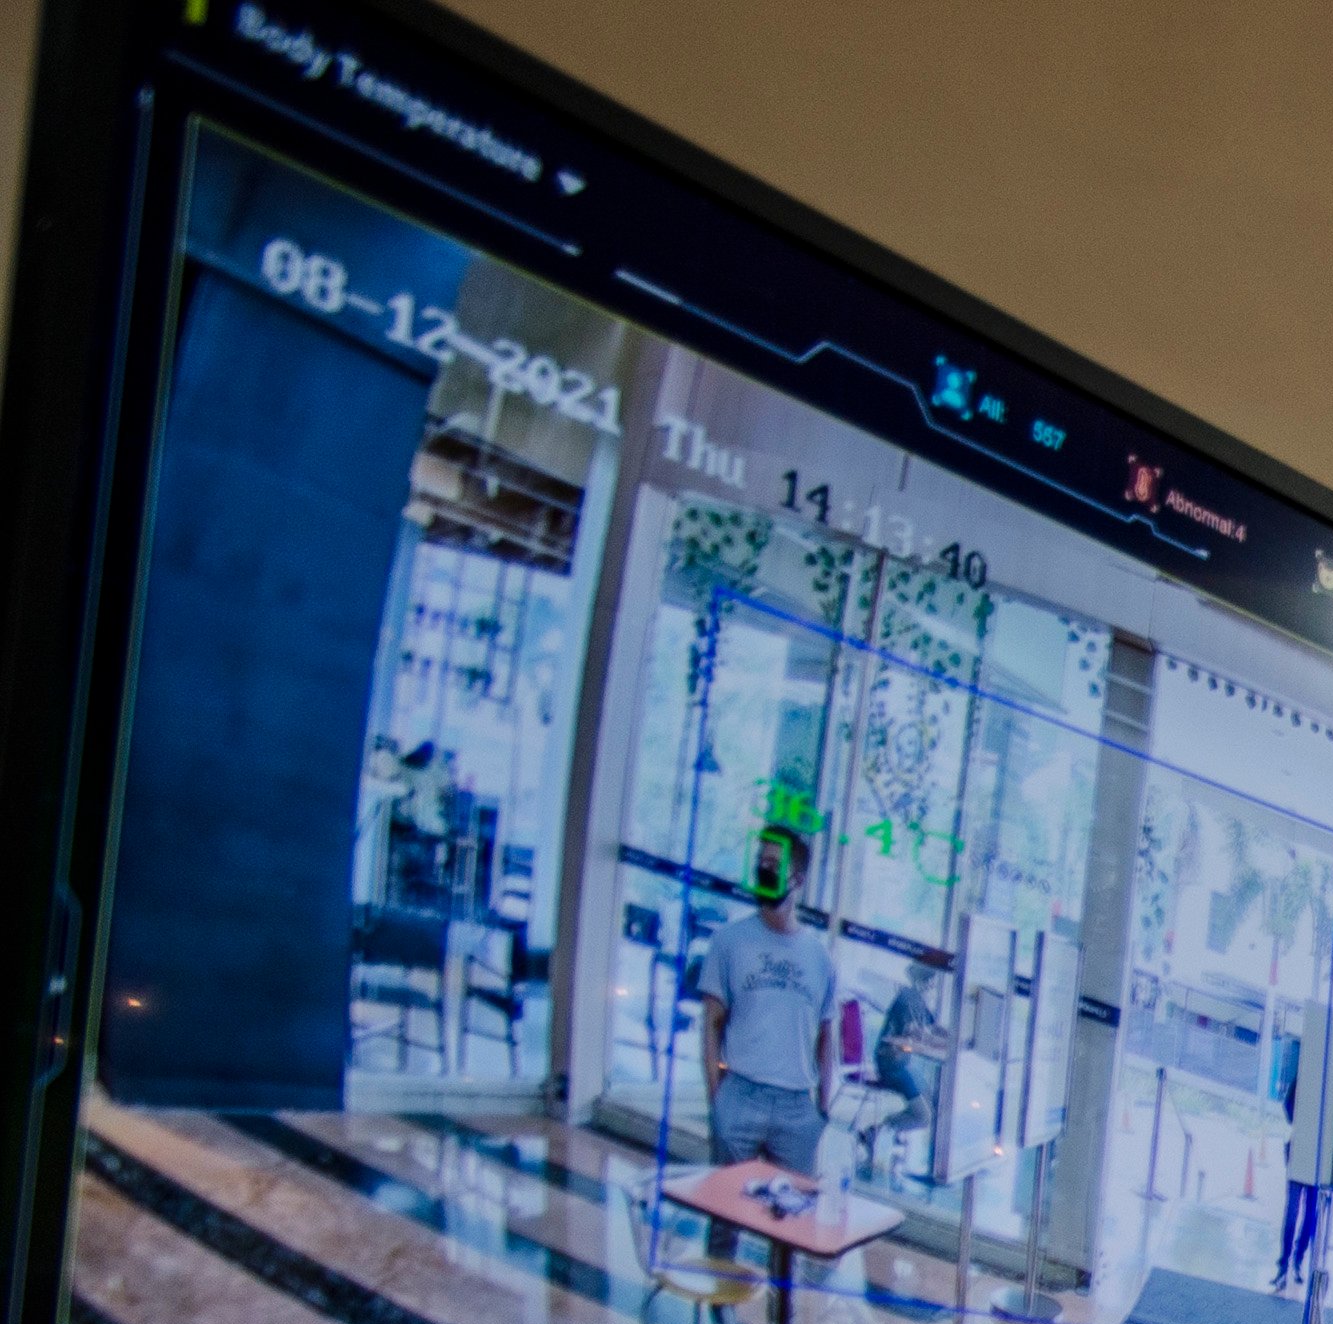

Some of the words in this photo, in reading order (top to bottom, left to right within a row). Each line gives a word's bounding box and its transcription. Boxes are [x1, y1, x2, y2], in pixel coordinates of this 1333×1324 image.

[236, 2, 332, 80] Body
[336, 52, 544, 183] Temperature
[261, 237, 622, 436] 08-12-2021
[655, 415, 746, 490] Thu
[779, 469, 989, 591] 14:13:40
